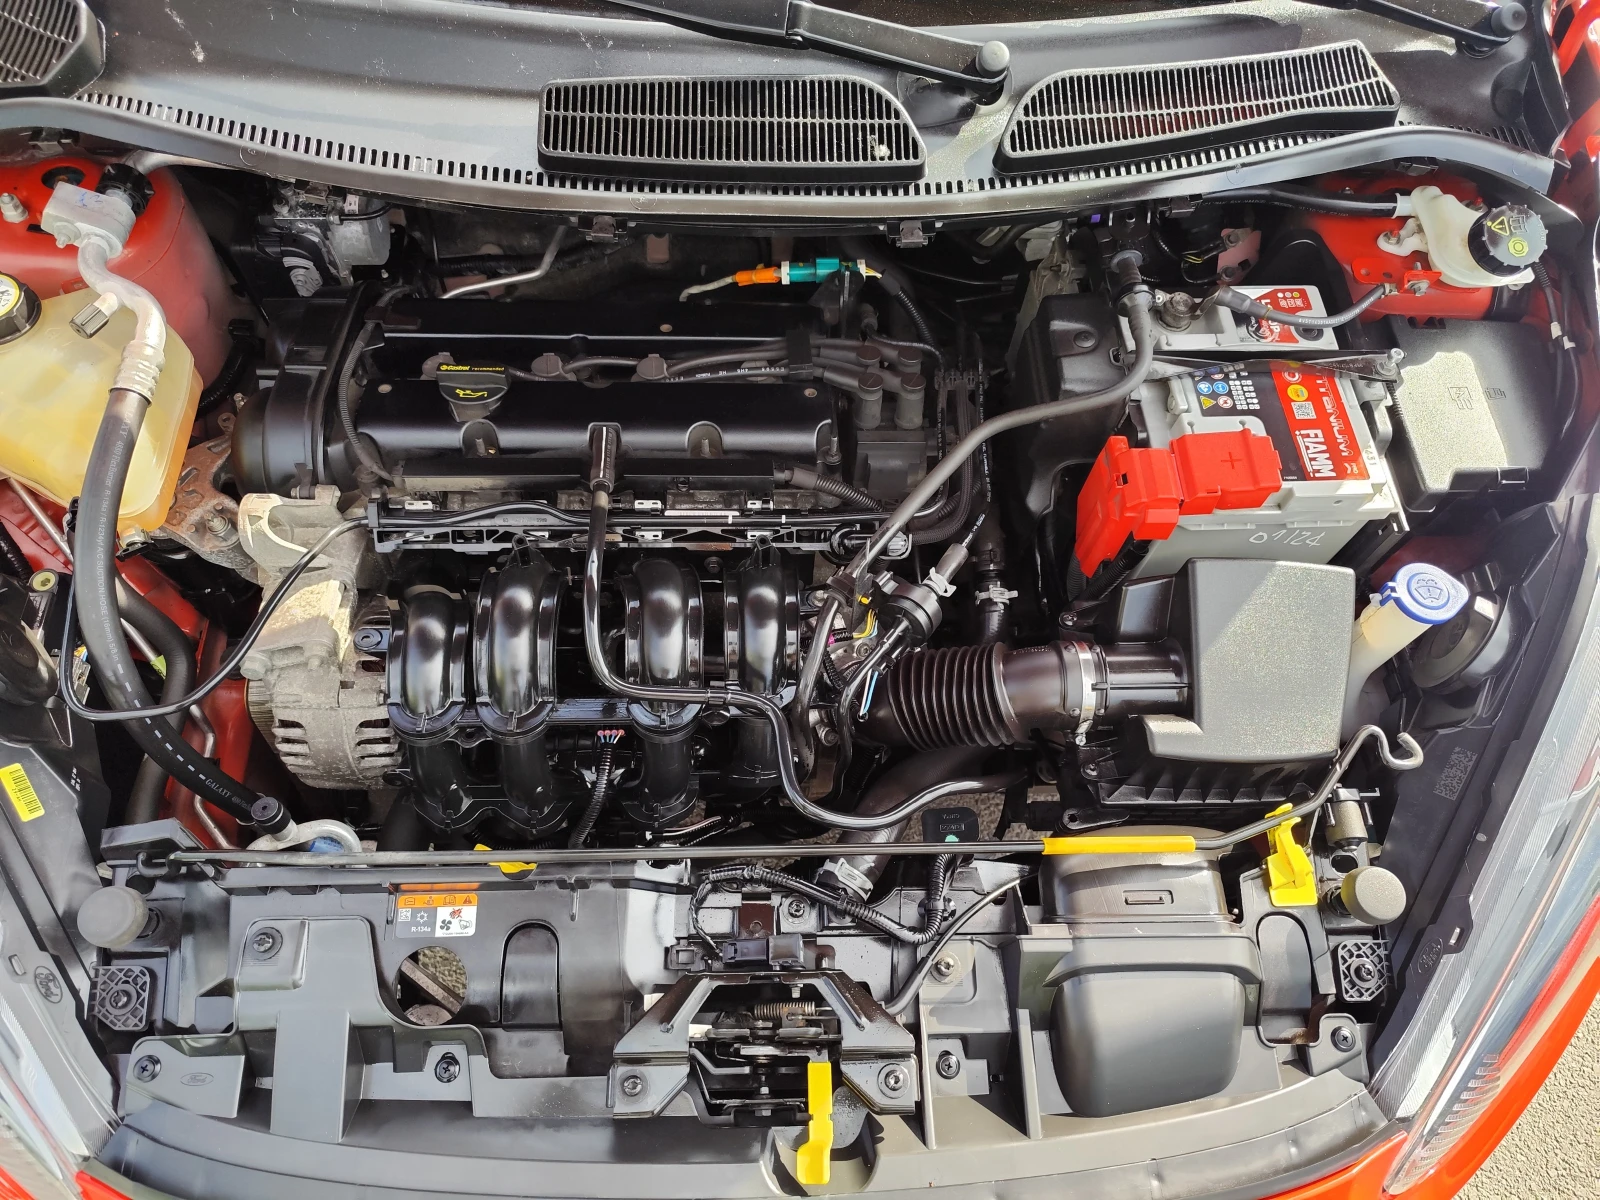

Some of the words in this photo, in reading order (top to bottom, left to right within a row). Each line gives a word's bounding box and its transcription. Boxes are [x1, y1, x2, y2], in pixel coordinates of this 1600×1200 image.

[1301, 429, 1336, 477] FIAMM
[97, 561, 105, 593] SUCTION
[99, 594, 108, 616] HOSE
[100, 616, 113, 642] (16mm)
[205, 779, 232, 798] GALAXY
[36, 969, 61, 1000] Ford
[186, 1074, 208, 1084] Ford
